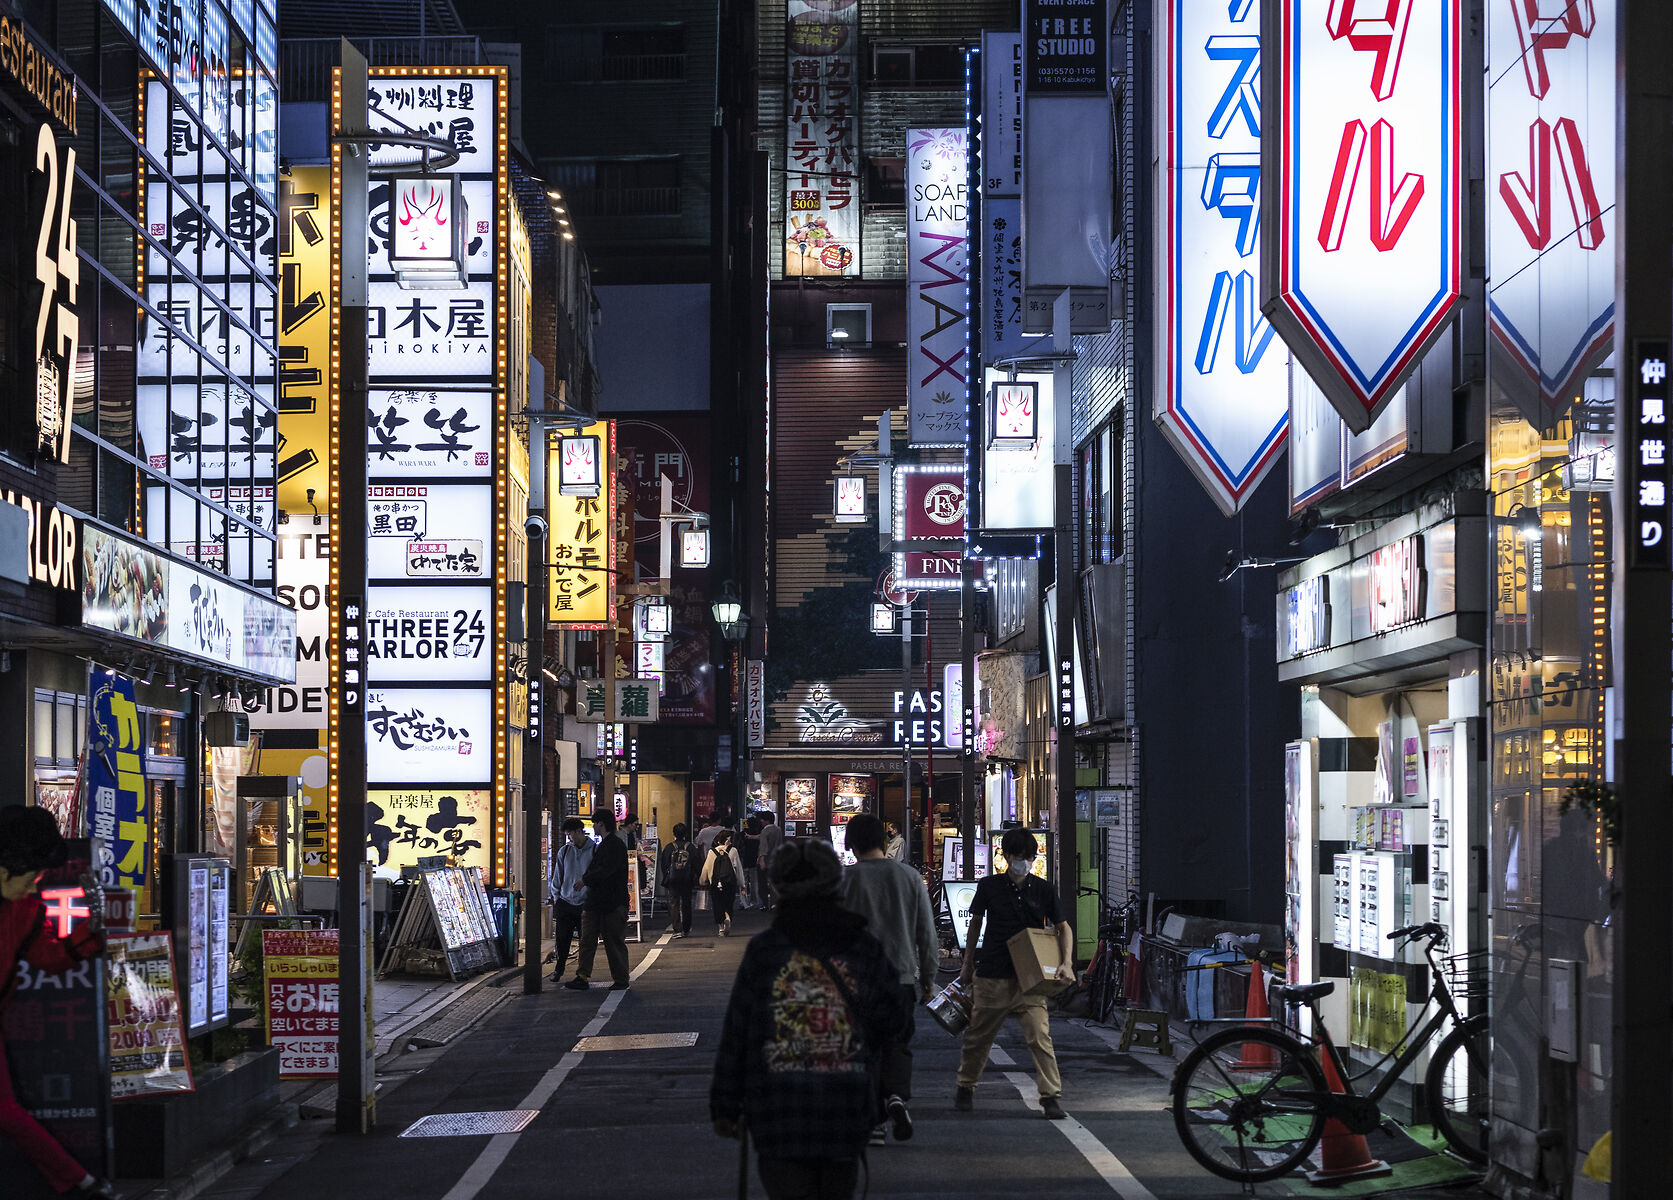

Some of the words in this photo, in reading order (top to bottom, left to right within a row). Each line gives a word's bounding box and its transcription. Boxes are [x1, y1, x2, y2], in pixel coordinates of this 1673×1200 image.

[1041, 18, 1092, 35] FREE
[1037, 38, 1096, 56] STUDIO
[792, 60, 821, 188] 貸切パーティー
[825, 60, 852, 210] カラオケパセラ
[914, 184, 967, 201] SOAP
[988, 178, 1002, 189] 3F
[915, 205, 967, 222] LAND
[925, 422, 962, 432] マックス
[1639, 358, 1666, 547] 仲見世通り
[373, 502, 419, 513] 俺の串かつ
[373, 514, 418, 534] 黒田
[0, 488, 76, 591] RLOR
[555, 543, 574, 611] おいで屋
[278, 584, 329, 610] SO
[375, 610, 396, 618] Cafe
[398, 610, 449, 618] Restaurant
[367, 619, 449, 638] THREE
[345, 605, 360, 705] 仲見世通り
[750, 664, 760, 741] カラオケパセラ
[1061, 661, 1072, 727] 仲見世通り
[530, 680, 539, 738] 仲見世通り
[851, 762, 886, 770] PASELA
[889, 762, 929, 770] RESTS
[389, 793, 434, 809] 居楽屋
[270, 963, 339, 973] いらっしゃいま
[274, 1041, 339, 1053] すぐにご案
